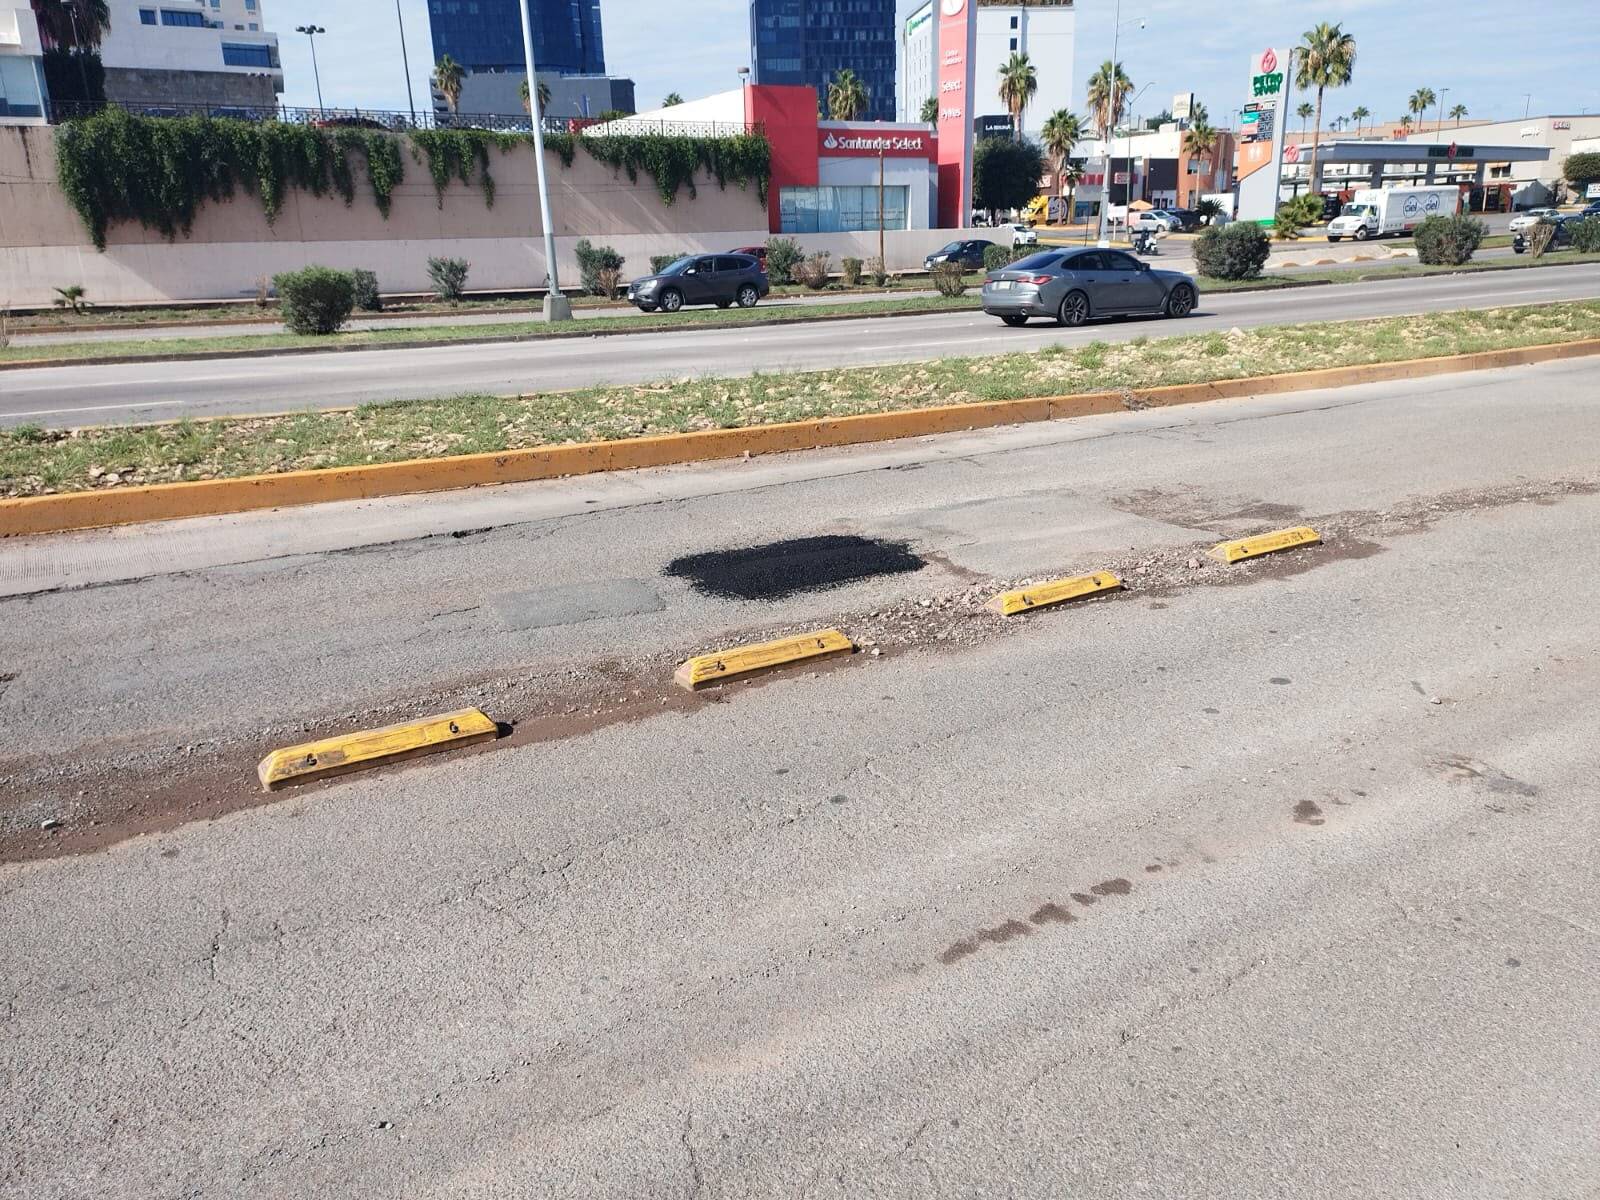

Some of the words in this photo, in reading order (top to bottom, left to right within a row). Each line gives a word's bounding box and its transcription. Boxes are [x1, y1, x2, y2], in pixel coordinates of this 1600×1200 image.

[1253, 72, 1283, 87] PETRO
[839, 136, 890, 150] Santander
[893, 137, 922, 150] Select
[1405, 201, 1417, 212] ciel
[1426, 199, 1438, 211] ciel
